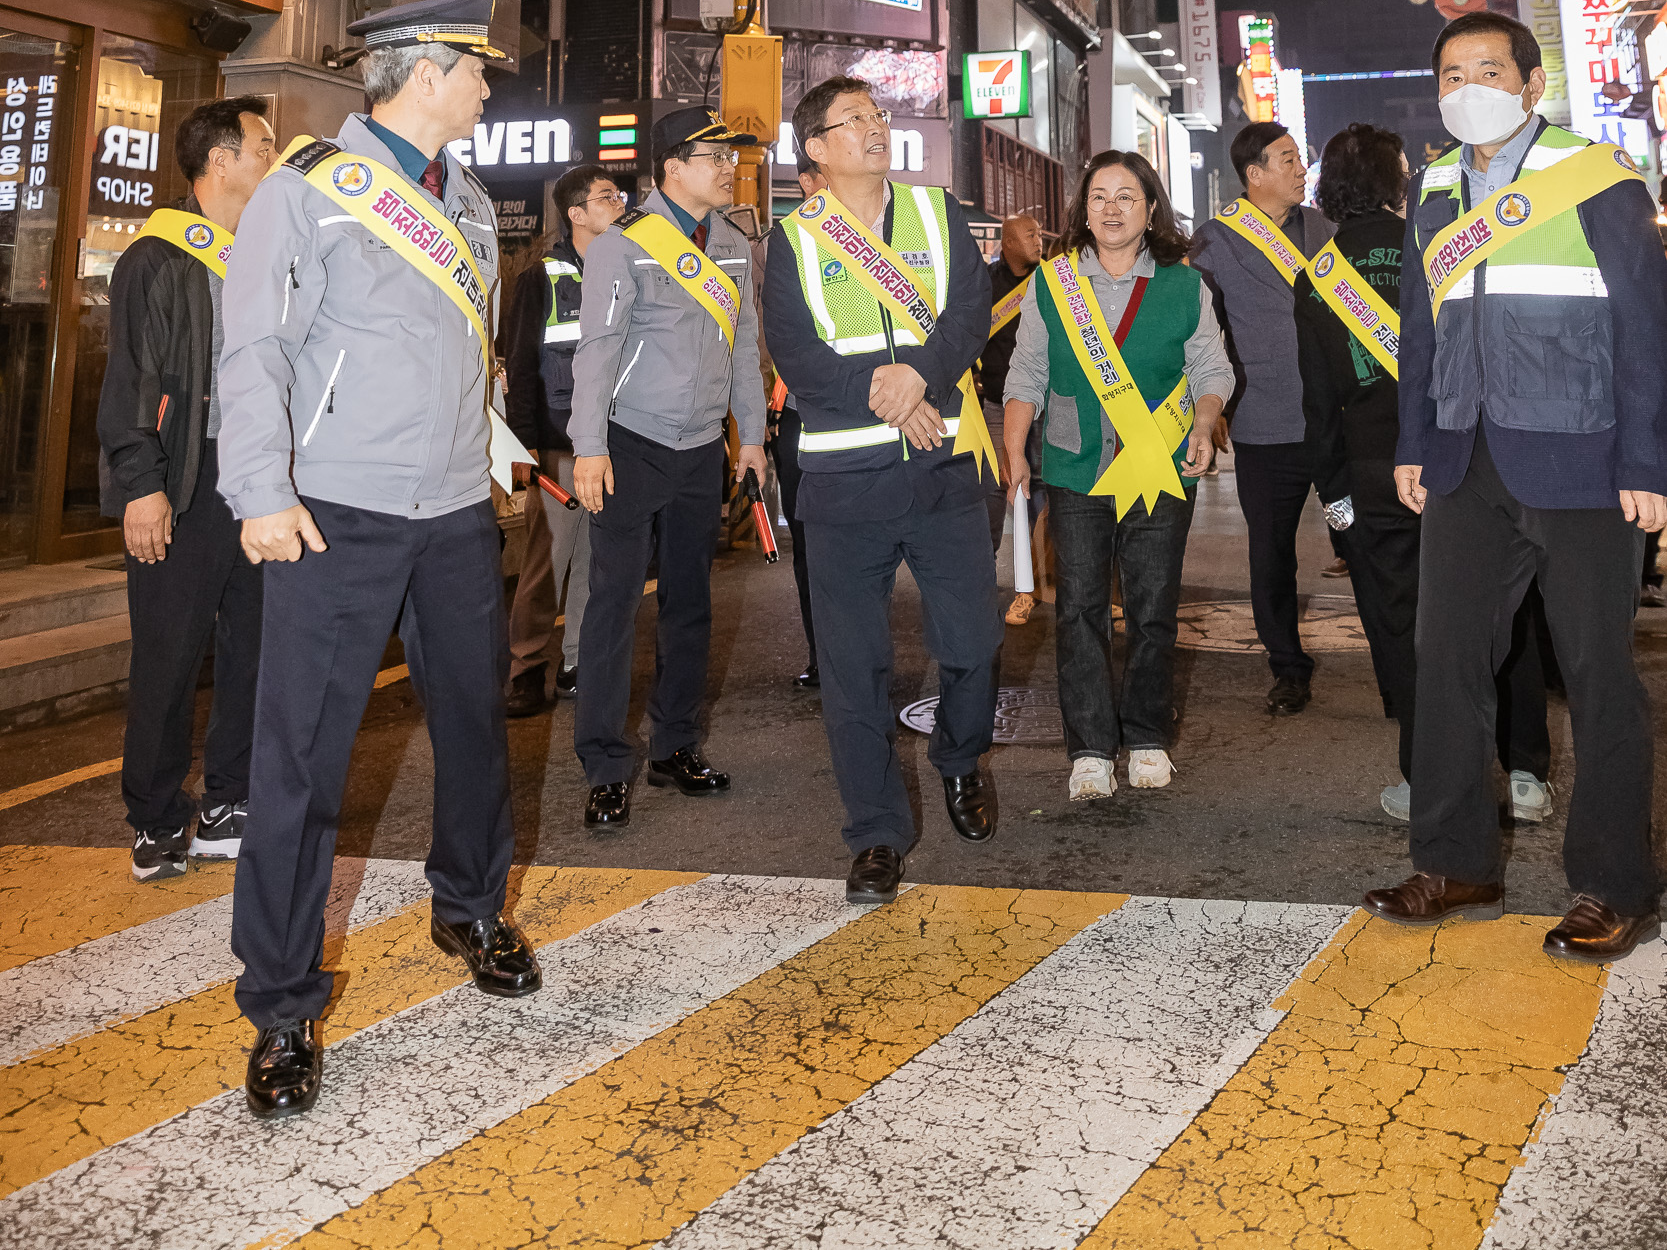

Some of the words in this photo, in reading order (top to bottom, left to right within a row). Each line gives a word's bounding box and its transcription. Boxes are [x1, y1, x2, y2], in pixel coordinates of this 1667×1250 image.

[372, 188, 458, 268] 범죄없는
[1238, 212, 1276, 244] 안전하고
[1269, 239, 1297, 269] 건전한
[820, 213, 881, 269] 안전하고
[869, 257, 919, 306] 건전한
[1052, 255, 1081, 295] 안전하고
[1428, 216, 1493, 288] 범죄없는
[1065, 291, 1093, 327] 건전한
[1332, 278, 1380, 330] 범죄없는
[1078, 323, 1108, 363] 청년의
[1094, 358, 1121, 387] 거리
[1102, 382, 1135, 402] 화양지구대
